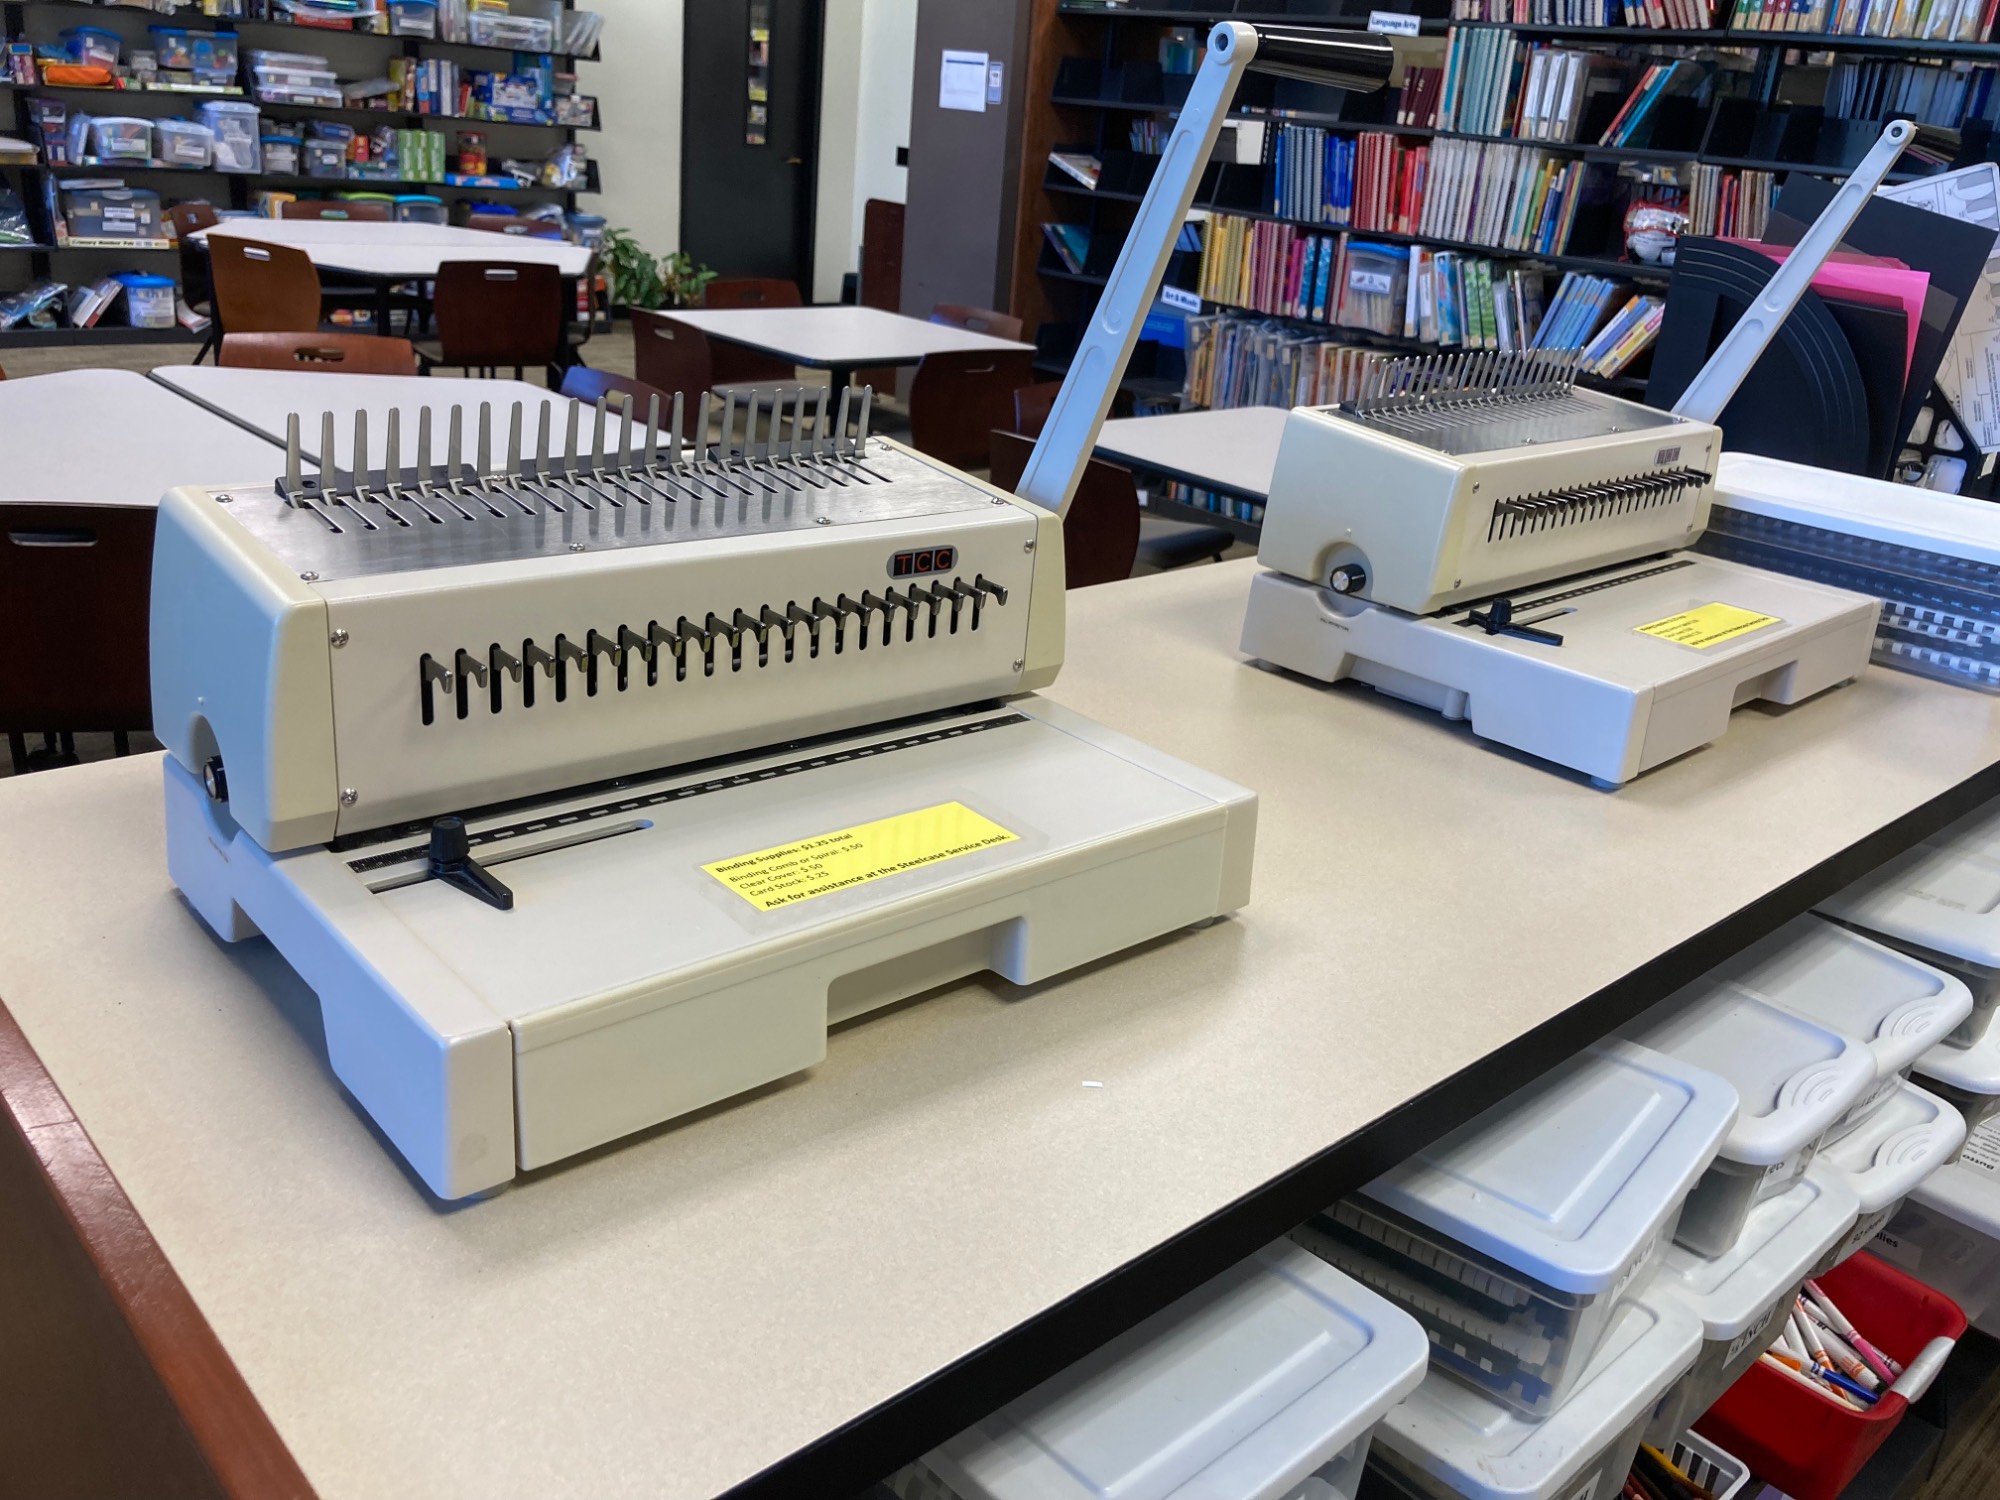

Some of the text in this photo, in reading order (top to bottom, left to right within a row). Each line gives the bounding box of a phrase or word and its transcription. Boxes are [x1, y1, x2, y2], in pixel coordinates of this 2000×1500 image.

[1371, 15, 1402, 29] Language
[896, 550, 951, 575] TCC
[716, 833, 853, 873] Binding Supplies: $1.25 total
[729, 868, 769, 882] Binding
[769, 860, 799, 872] Comb
[811, 849, 842, 861] Spiral:
[739, 879, 766, 890] Clear
[767, 870, 800, 882] Cover:
[750, 886, 775, 897] Card
[775, 878, 807, 891] Stock:
[765, 897, 787, 908] Ask
[787, 891, 806, 901] for
[807, 875, 865, 895] assistance
[878, 865, 898, 875] the
[897, 852, 947, 869] Steelcase
[945, 842, 982, 855] Service
